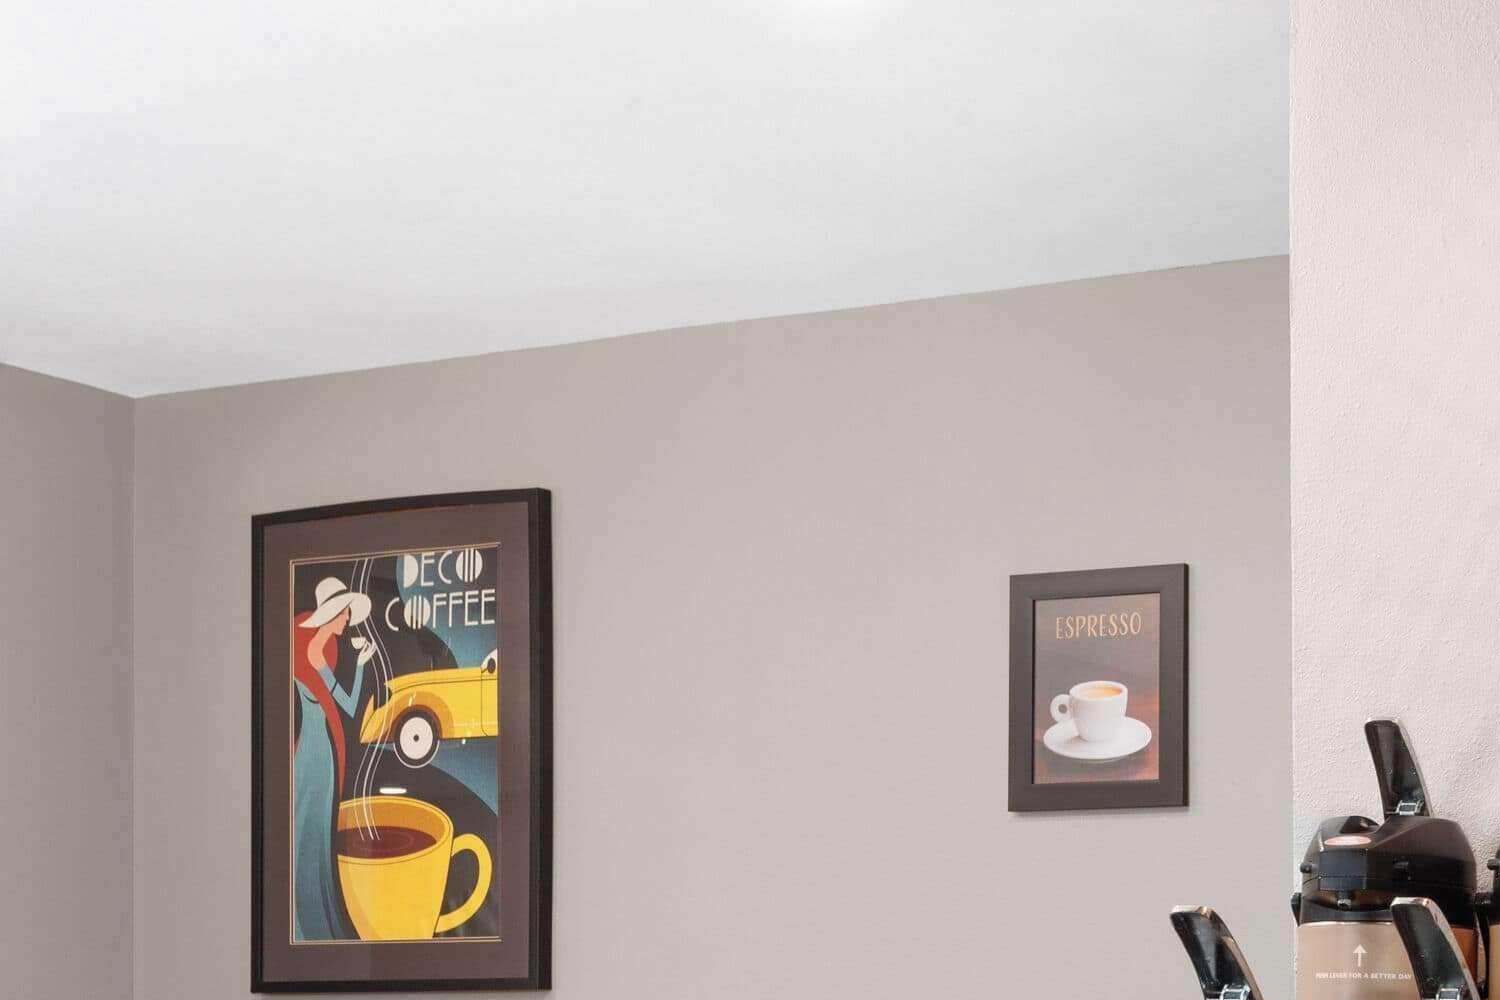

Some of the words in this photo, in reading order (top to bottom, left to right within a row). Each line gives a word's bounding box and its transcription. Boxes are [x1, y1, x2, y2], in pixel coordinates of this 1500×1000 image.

[403, 548, 483, 588] DECO
[385, 588, 496, 632] COFFEE
[1055, 611, 1142, 640] ESPRESSO
